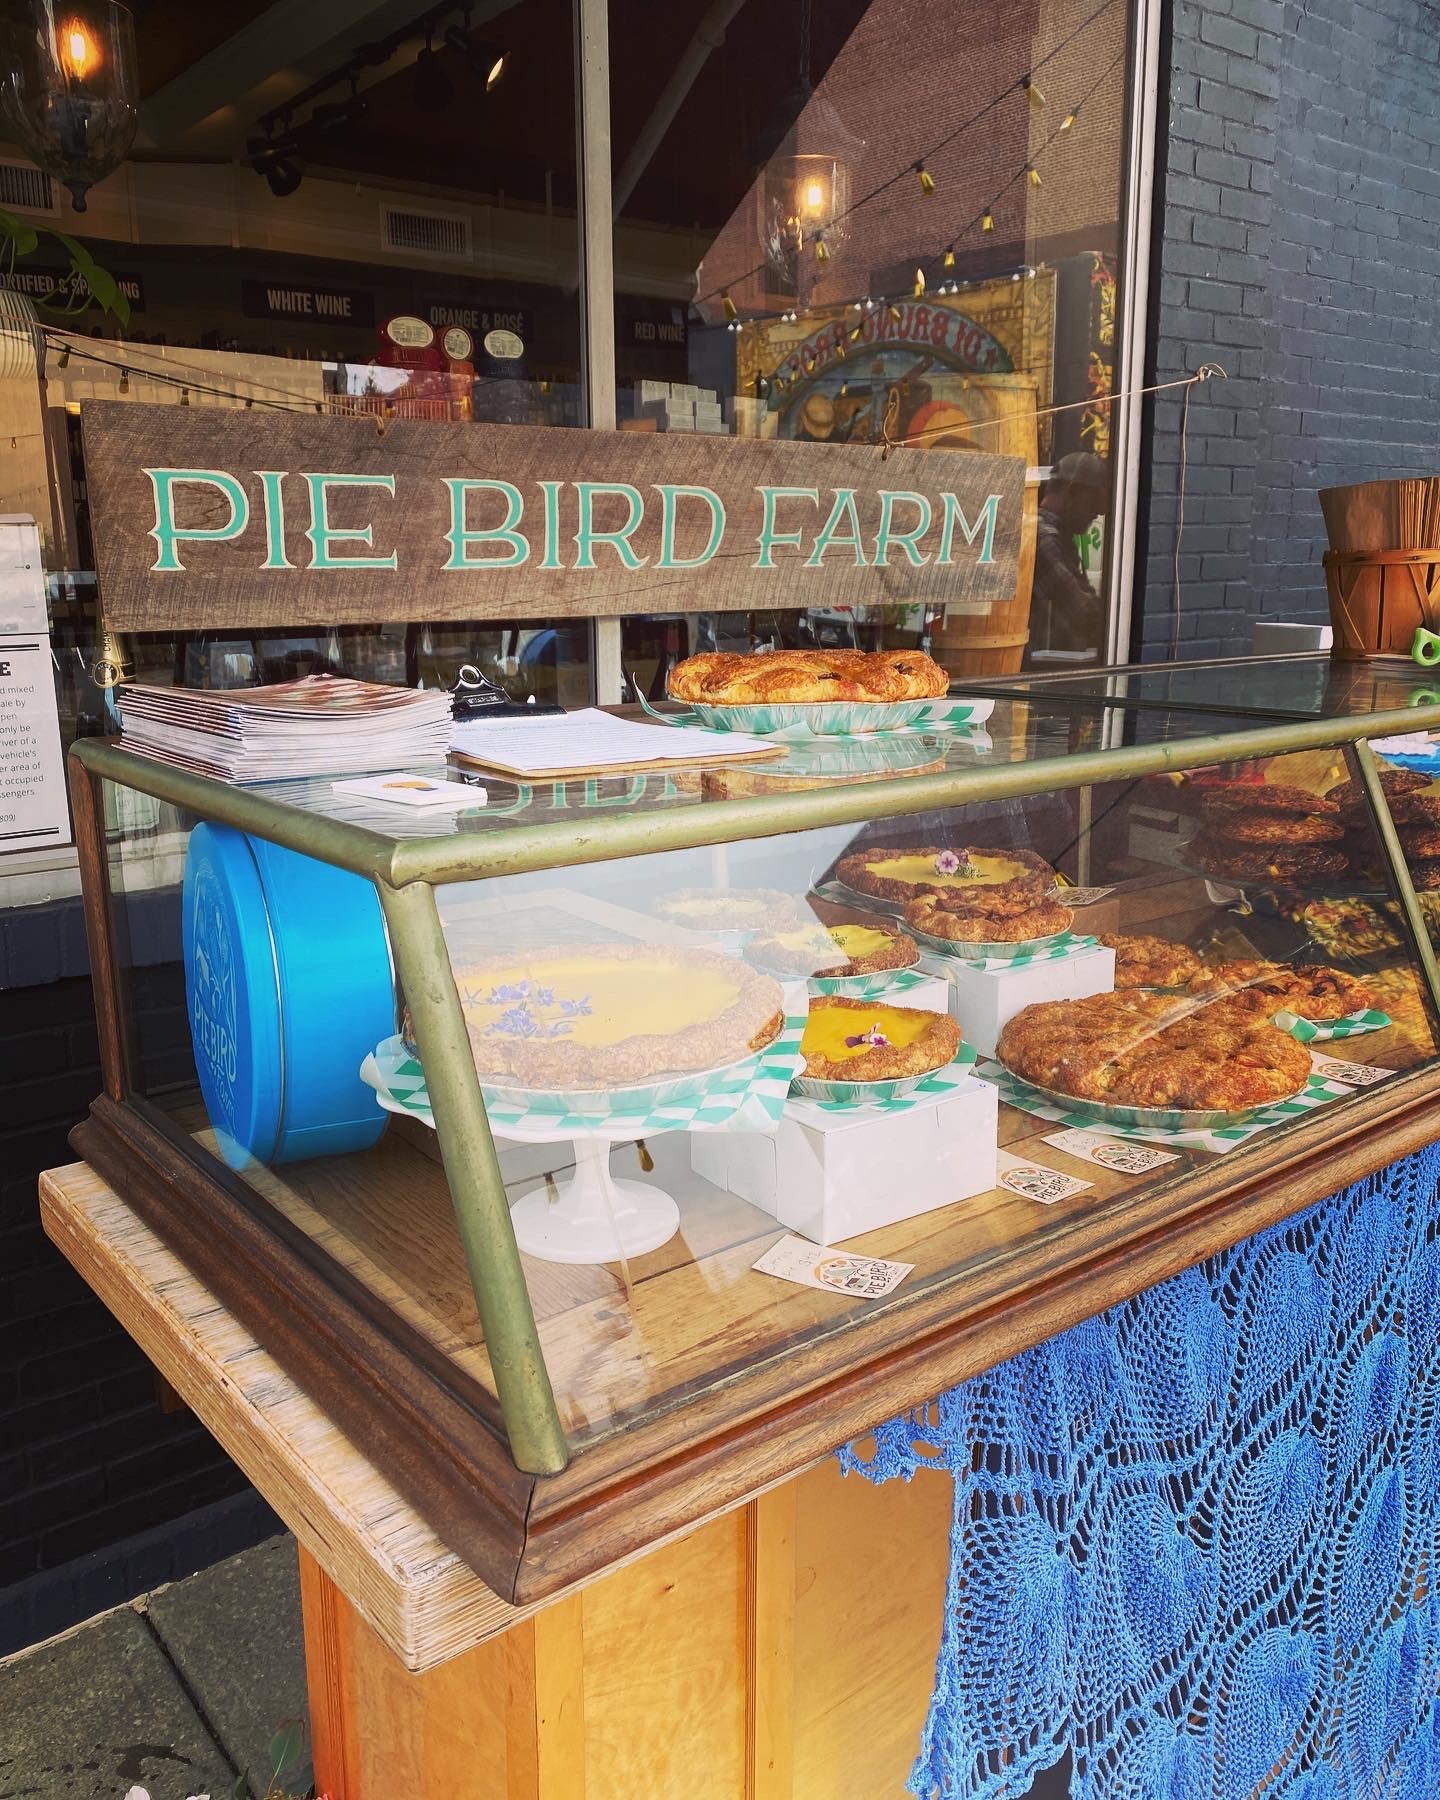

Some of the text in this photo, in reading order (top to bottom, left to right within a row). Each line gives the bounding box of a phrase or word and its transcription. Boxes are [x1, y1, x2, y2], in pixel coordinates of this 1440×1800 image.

[0, 272, 55, 293] ORTIFIED
[267, 289, 352, 317] WHITE WINE
[430, 306, 524, 334] ORANGE & ROSÉ
[634, 321, 686, 343] RED WINE
[141, 467, 398, 572] PIE
[439, 477, 727, 571] BIRD
[750, 485, 1004, 568] FARM
[8, 684, 35, 694] mixed
[0, 699, 26, 709] ale by
[0, 712, 18, 723] pen
[20, 723, 31, 733] be
[20, 737, 29, 746] of
[10, 763, 30, 773] area
[32, 761, 41, 771] of
[5, 774, 44, 786] occupied
[194, 990, 238, 1082] PIEBIRD
[863, 1261, 889, 1295] PIEBIRD
